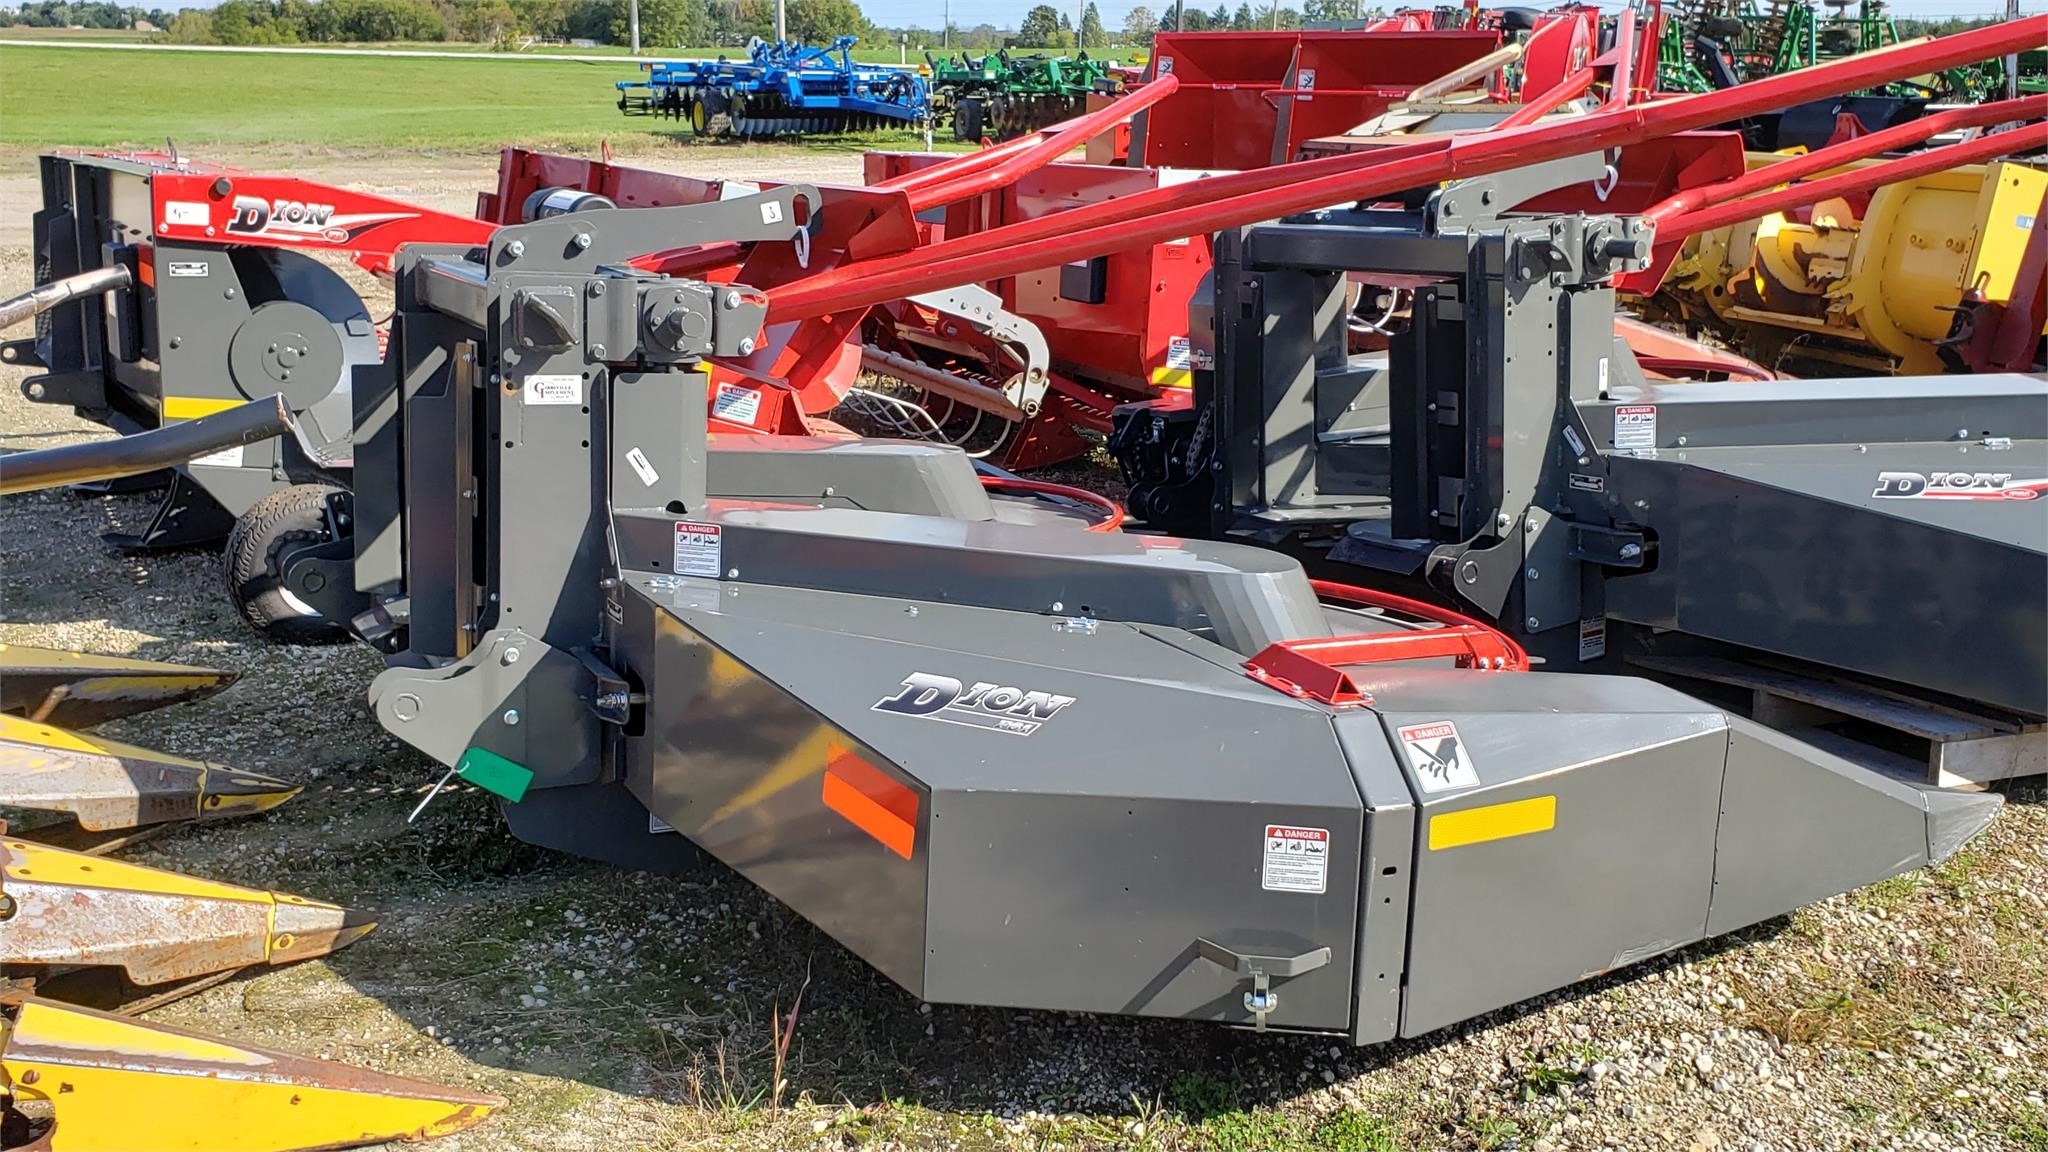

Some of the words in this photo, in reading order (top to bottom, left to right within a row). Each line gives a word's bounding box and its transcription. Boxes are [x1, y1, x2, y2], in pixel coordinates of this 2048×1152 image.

[225, 196, 334, 233] DION
[1872, 472, 2011, 498] DION
[688, 525, 715, 534] DANGER
[870, 672, 1076, 720] DION
[1415, 725, 1452, 739] DANGER
[1284, 830, 1321, 840] DANGER
